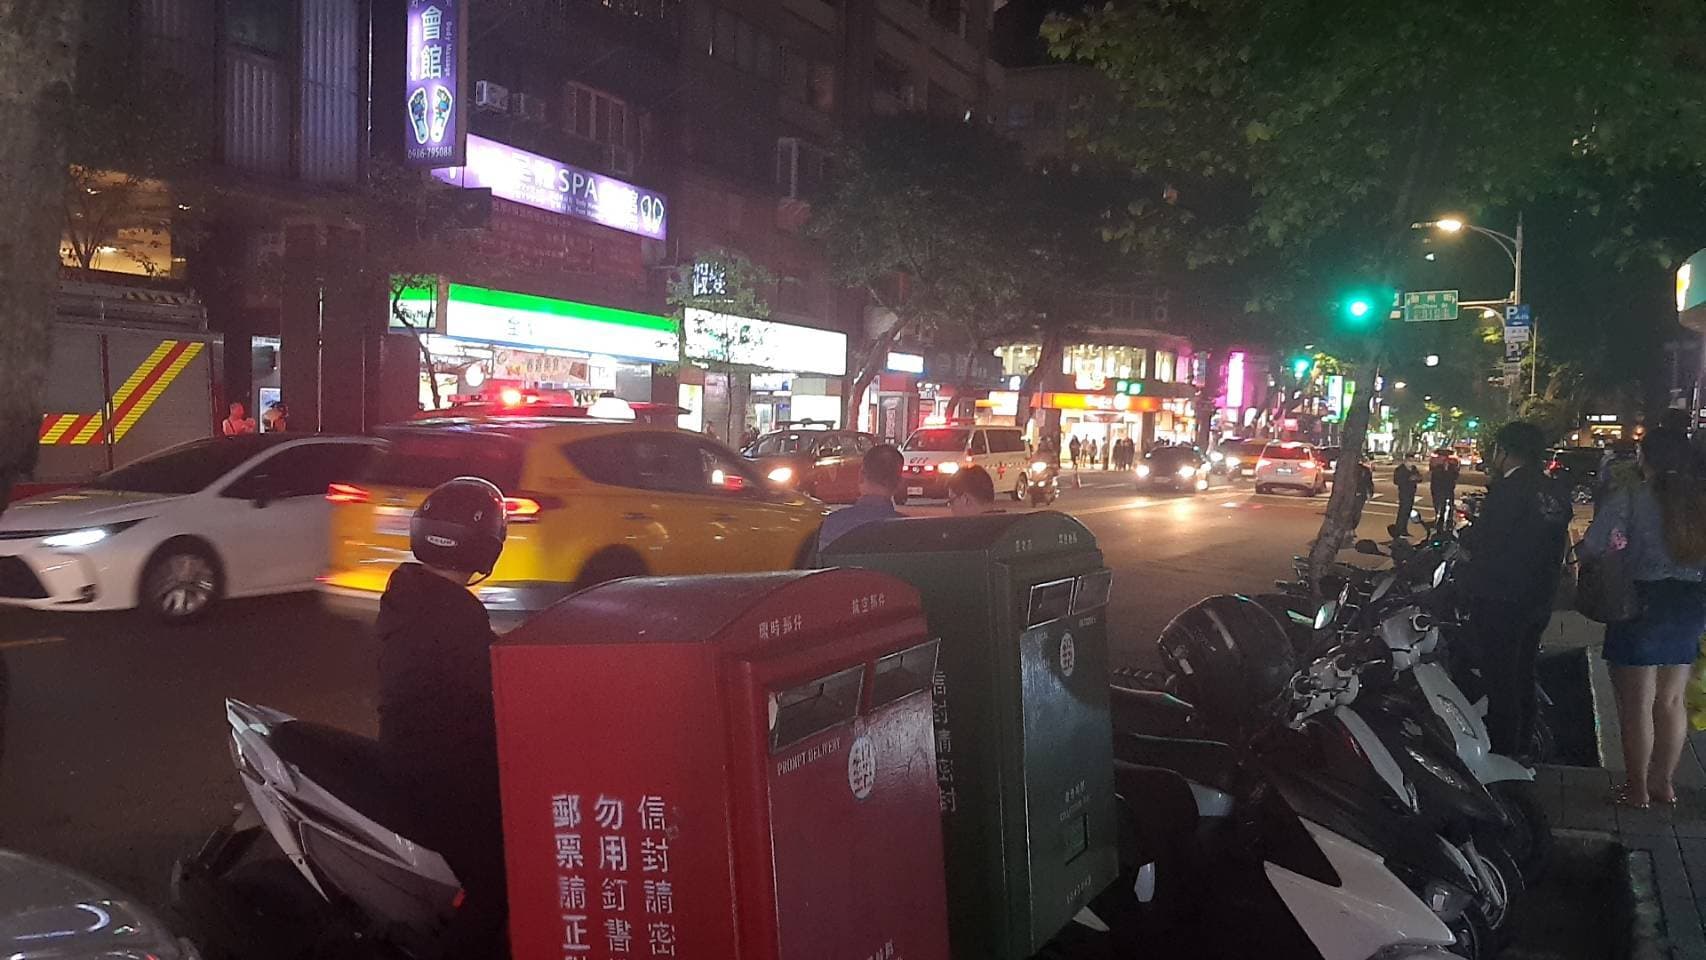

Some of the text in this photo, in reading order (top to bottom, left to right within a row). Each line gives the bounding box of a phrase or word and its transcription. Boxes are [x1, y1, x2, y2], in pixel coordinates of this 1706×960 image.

[421, 5, 442, 80] 會館
[558, 168, 599, 201] SPA
[758, 615, 803, 640] 限時郵件
[777, 736, 841, 777] PROMPT DELIVERY
[551, 793, 591, 960] 郵票請正
[594, 793, 633, 960] 勿用釘書
